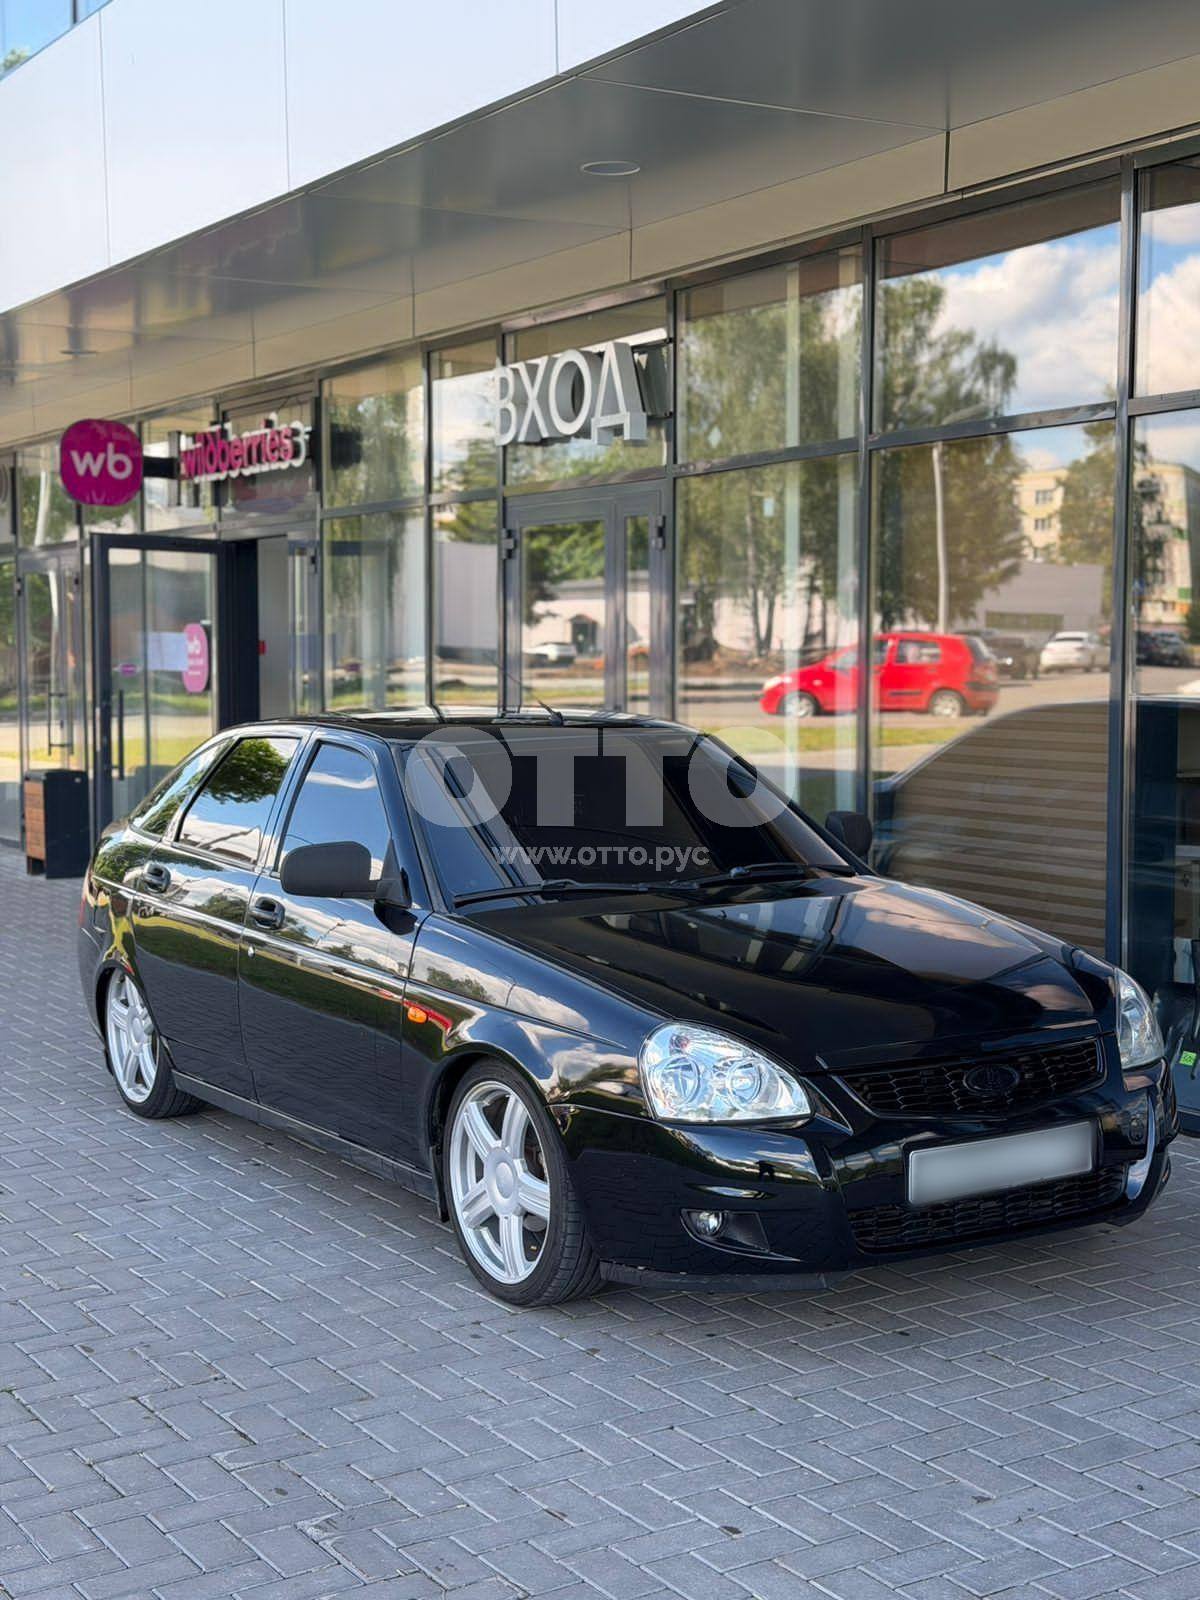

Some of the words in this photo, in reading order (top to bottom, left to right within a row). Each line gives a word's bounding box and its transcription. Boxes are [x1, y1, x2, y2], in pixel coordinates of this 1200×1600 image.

[494, 341, 640, 446] ВХОД
[70, 443, 133, 480] wb
[180, 416, 300, 481] wildberries
